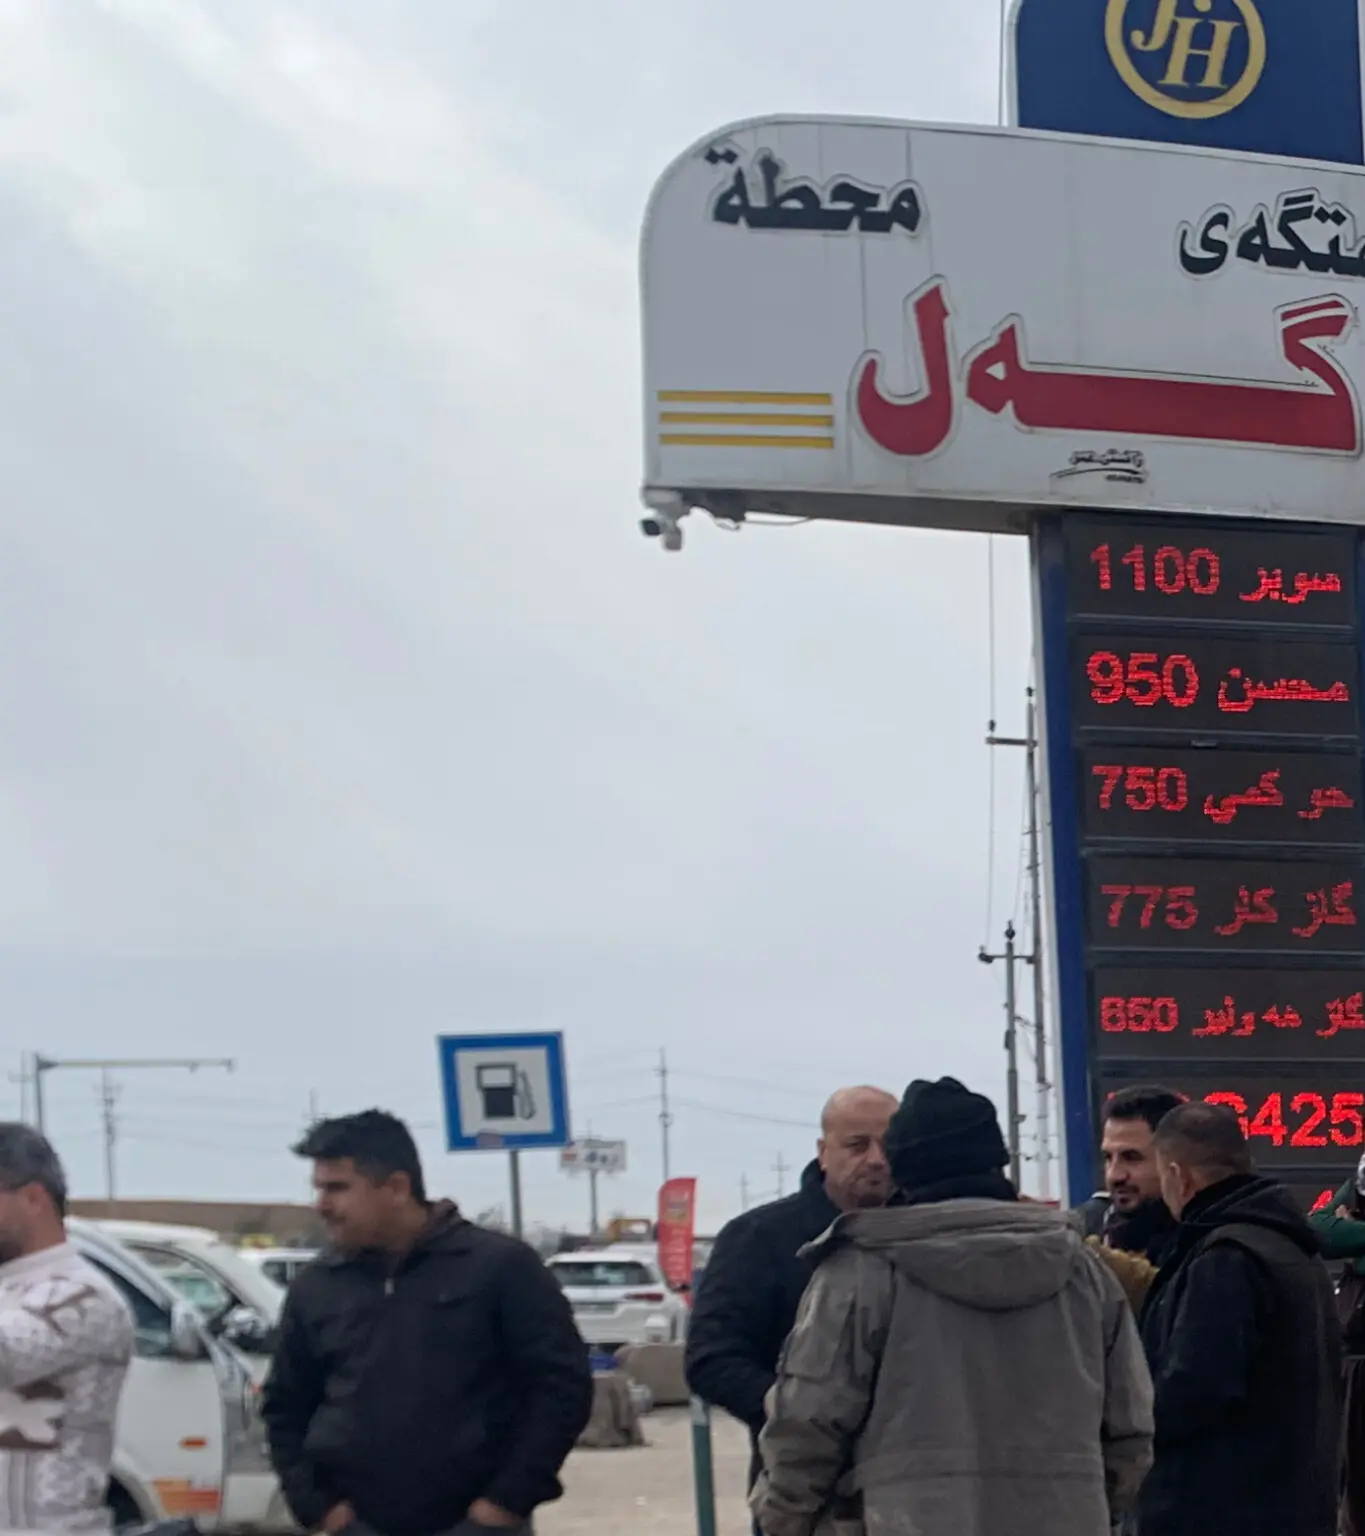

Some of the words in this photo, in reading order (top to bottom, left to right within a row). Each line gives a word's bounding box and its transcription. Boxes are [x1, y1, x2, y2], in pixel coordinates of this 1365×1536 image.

[704, 149, 922, 234] محطة
[1091, 544, 1220, 595] 1100
[1086, 651, 1200, 708] 950
[1092, 765, 1188, 812] 750
[1101, 885, 1198, 930] 775
[1203, 1091, 1365, 1147] 425
